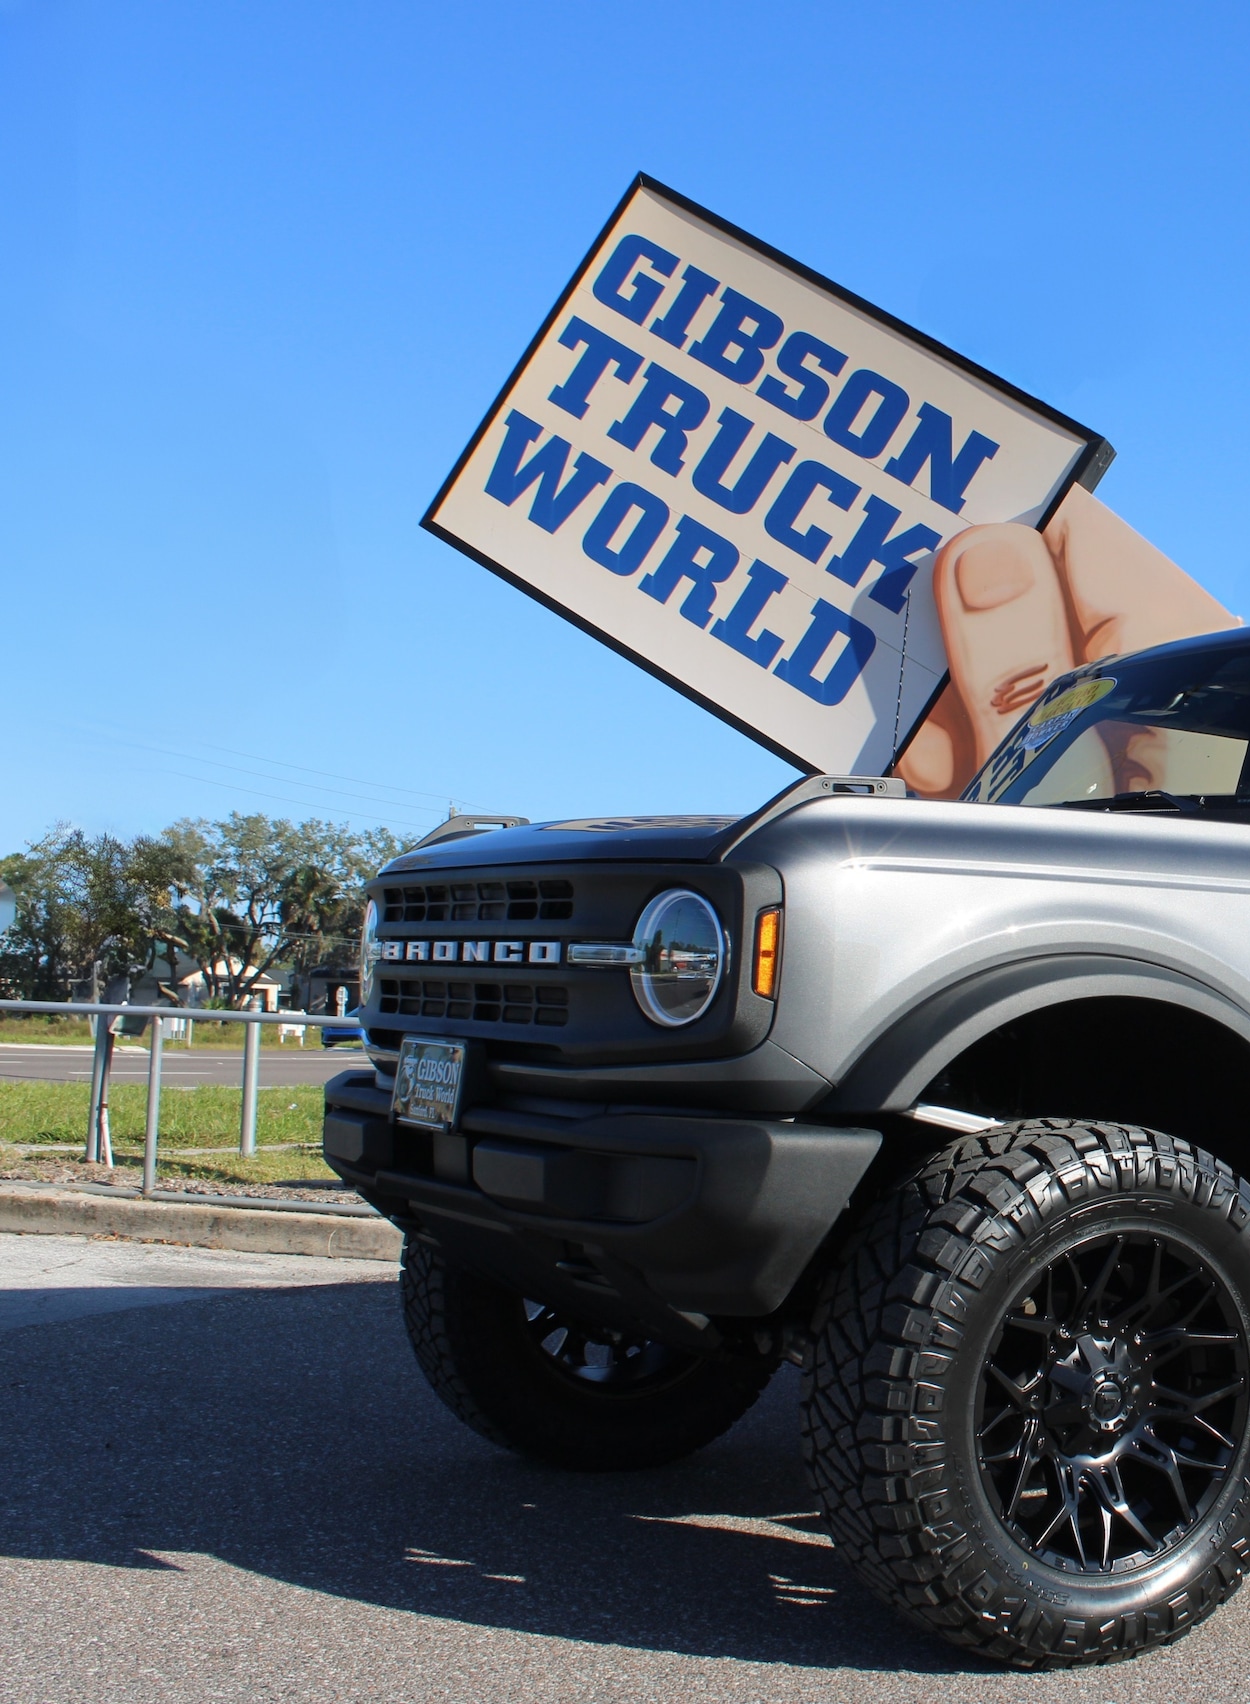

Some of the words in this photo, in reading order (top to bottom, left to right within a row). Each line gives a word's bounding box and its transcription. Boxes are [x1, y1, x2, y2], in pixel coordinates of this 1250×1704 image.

[592, 234, 1000, 515] GIBSON
[547, 315, 943, 615] TRUCK
[484, 408, 877, 707] WORLD
[382, 941, 561, 963] BRONCO
[415, 1083, 435, 1100] Truck
[435, 1086, 455, 1104] World
[417, 1058, 460, 1085] GIBSON
